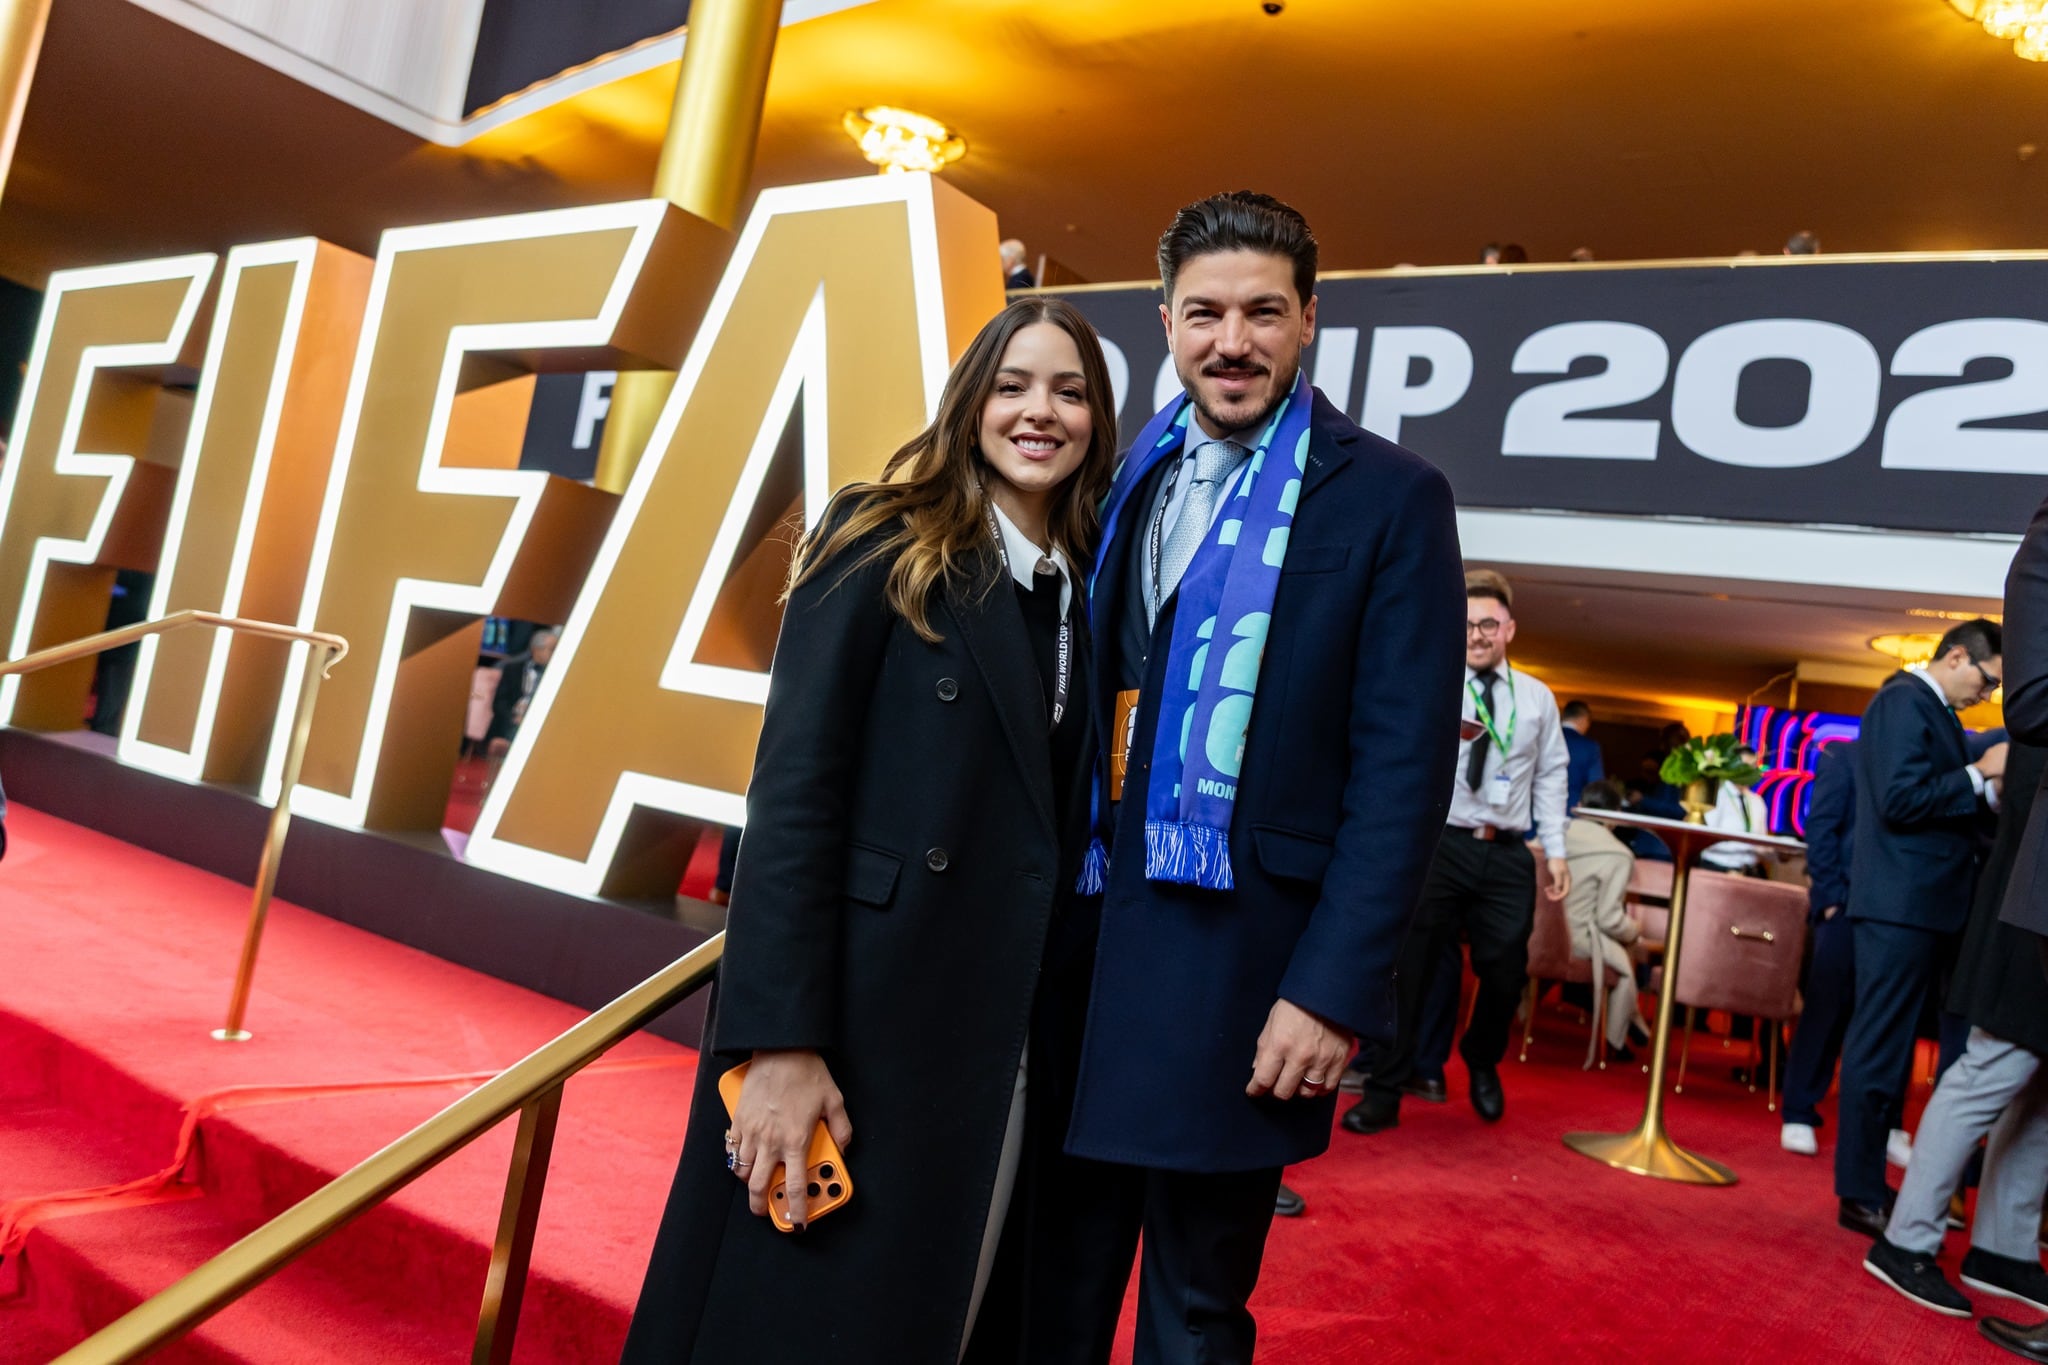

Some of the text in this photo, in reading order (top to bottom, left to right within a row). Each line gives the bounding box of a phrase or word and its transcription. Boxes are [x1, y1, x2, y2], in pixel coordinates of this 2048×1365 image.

[0, 171, 949, 897] FIFA
[1060, 625, 1069, 642] CUP
[1059, 642, 1068, 674] WORLD
[1058, 674, 1067, 695] FIFA
[1197, 777, 1238, 801] MON
